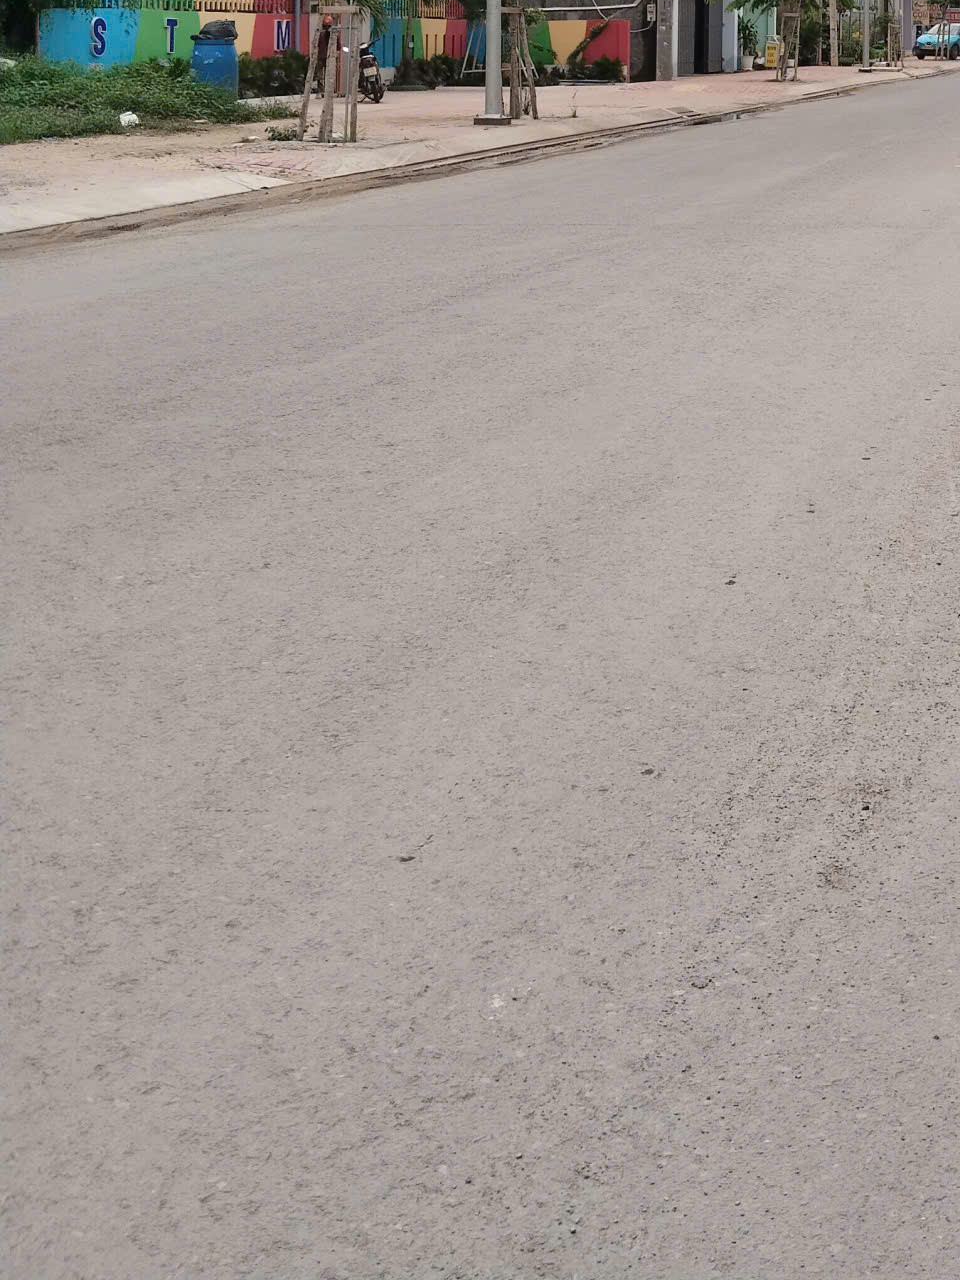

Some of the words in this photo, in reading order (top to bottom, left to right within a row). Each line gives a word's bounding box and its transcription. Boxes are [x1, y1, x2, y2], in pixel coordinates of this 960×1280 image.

[90, 17, 107, 57] S
[165, 17, 179, 54] T
[274, 19, 291, 52] M
